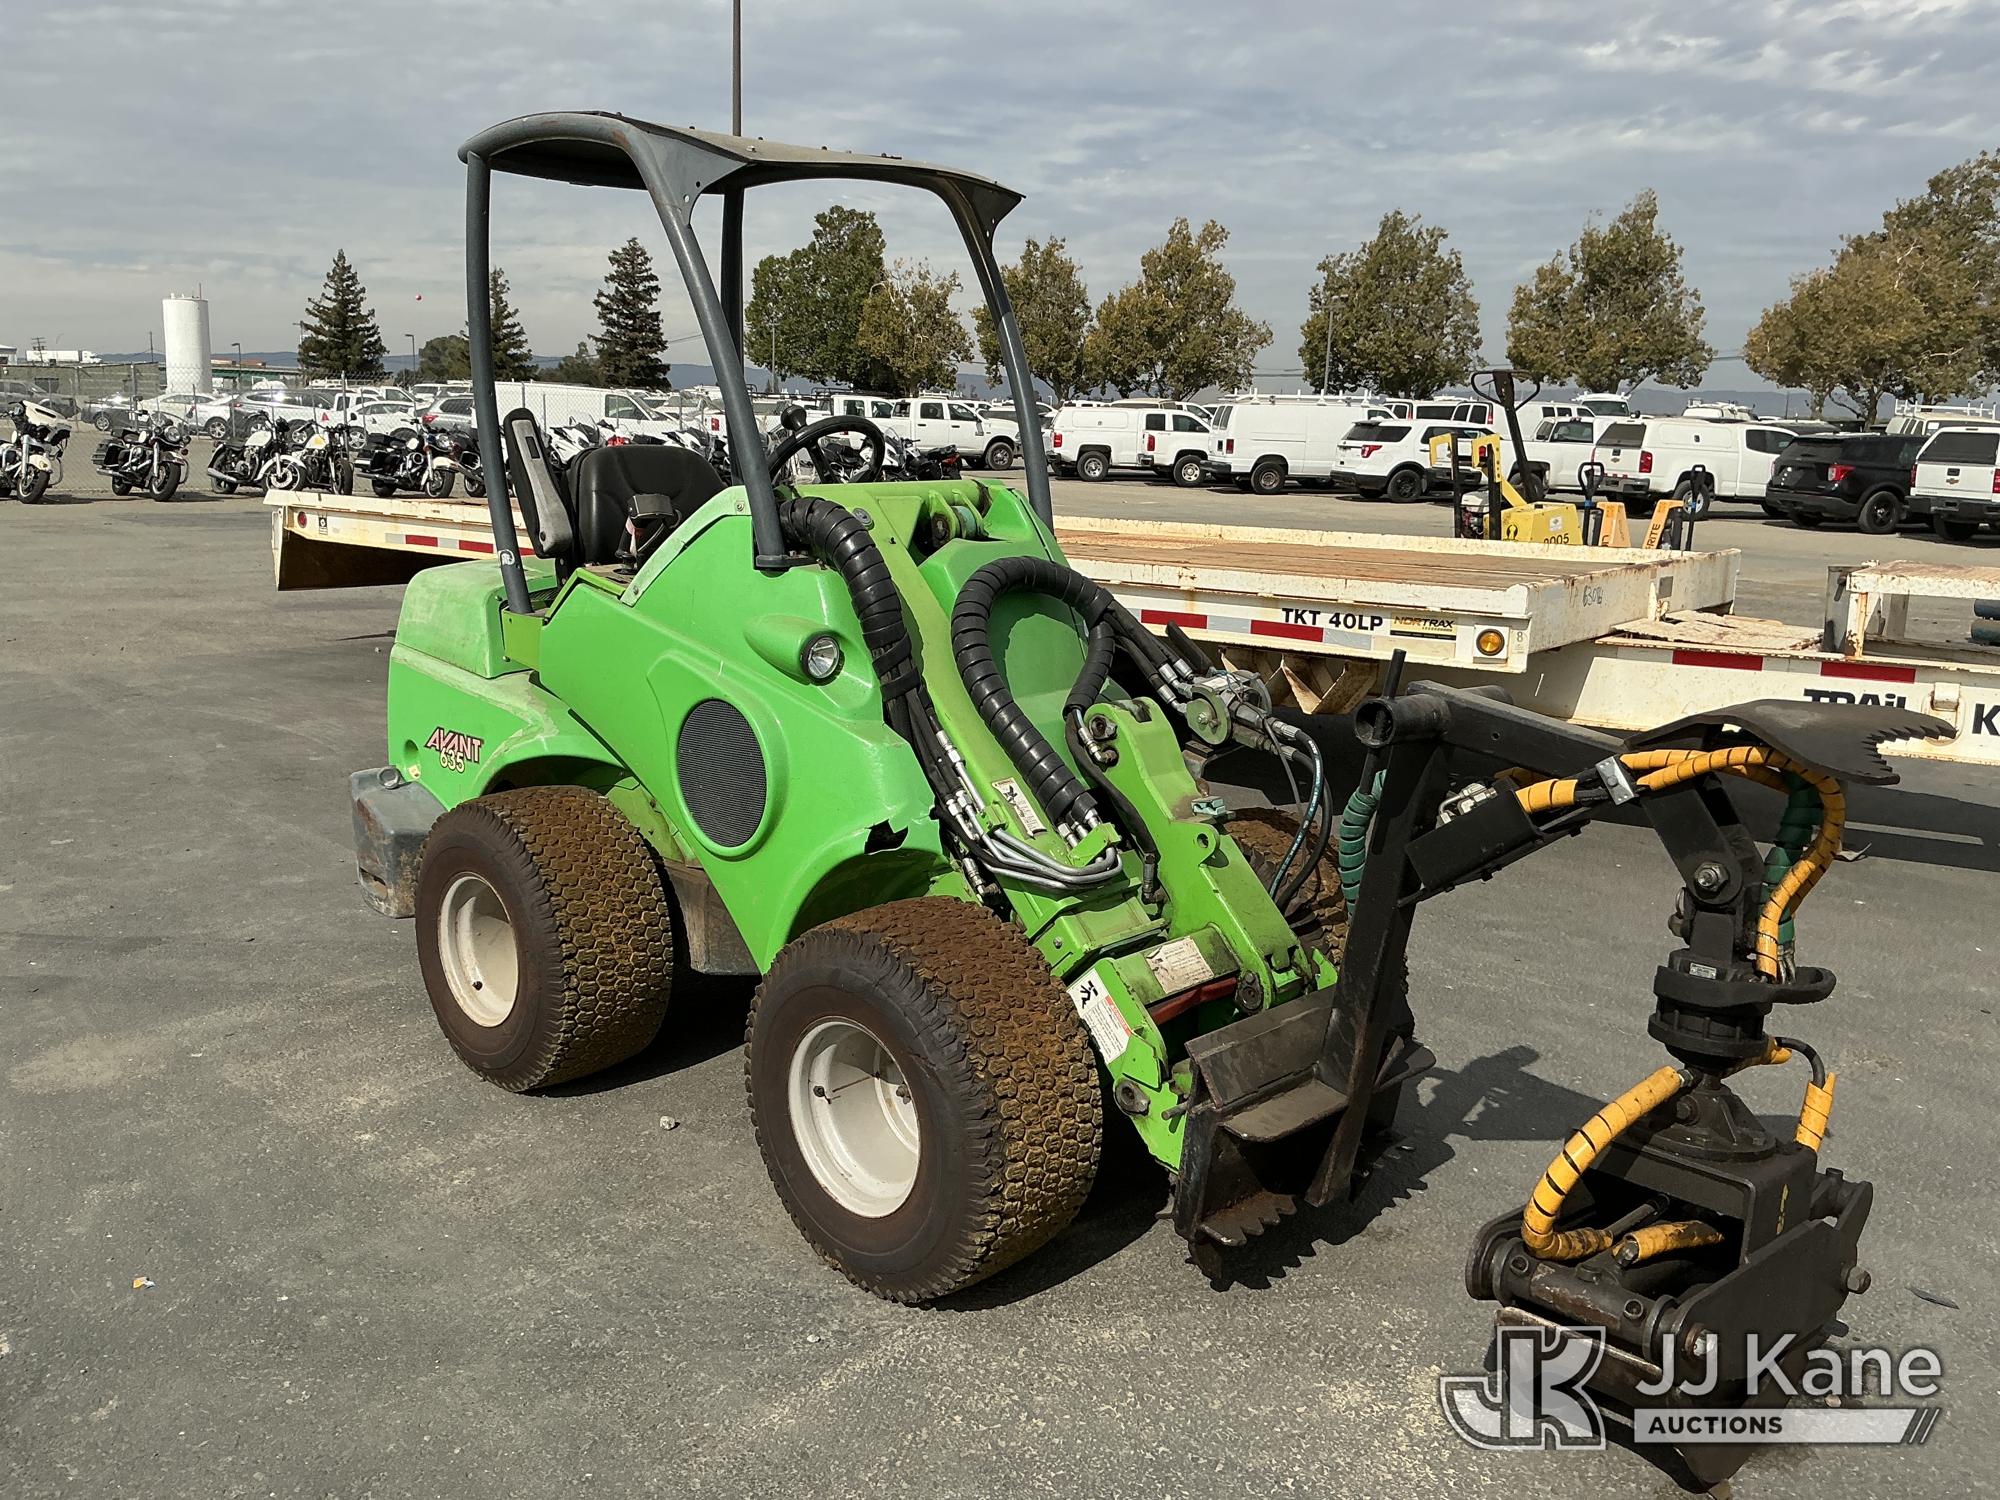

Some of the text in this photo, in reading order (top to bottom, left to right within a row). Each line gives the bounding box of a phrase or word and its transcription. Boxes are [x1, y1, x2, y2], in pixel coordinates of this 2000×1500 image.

[1281, 607, 1384, 632] TKT 40LP
[1393, 616, 1455, 629] NORTRAX
[424, 726, 484, 764] AVANT
[440, 747, 466, 774] 635
